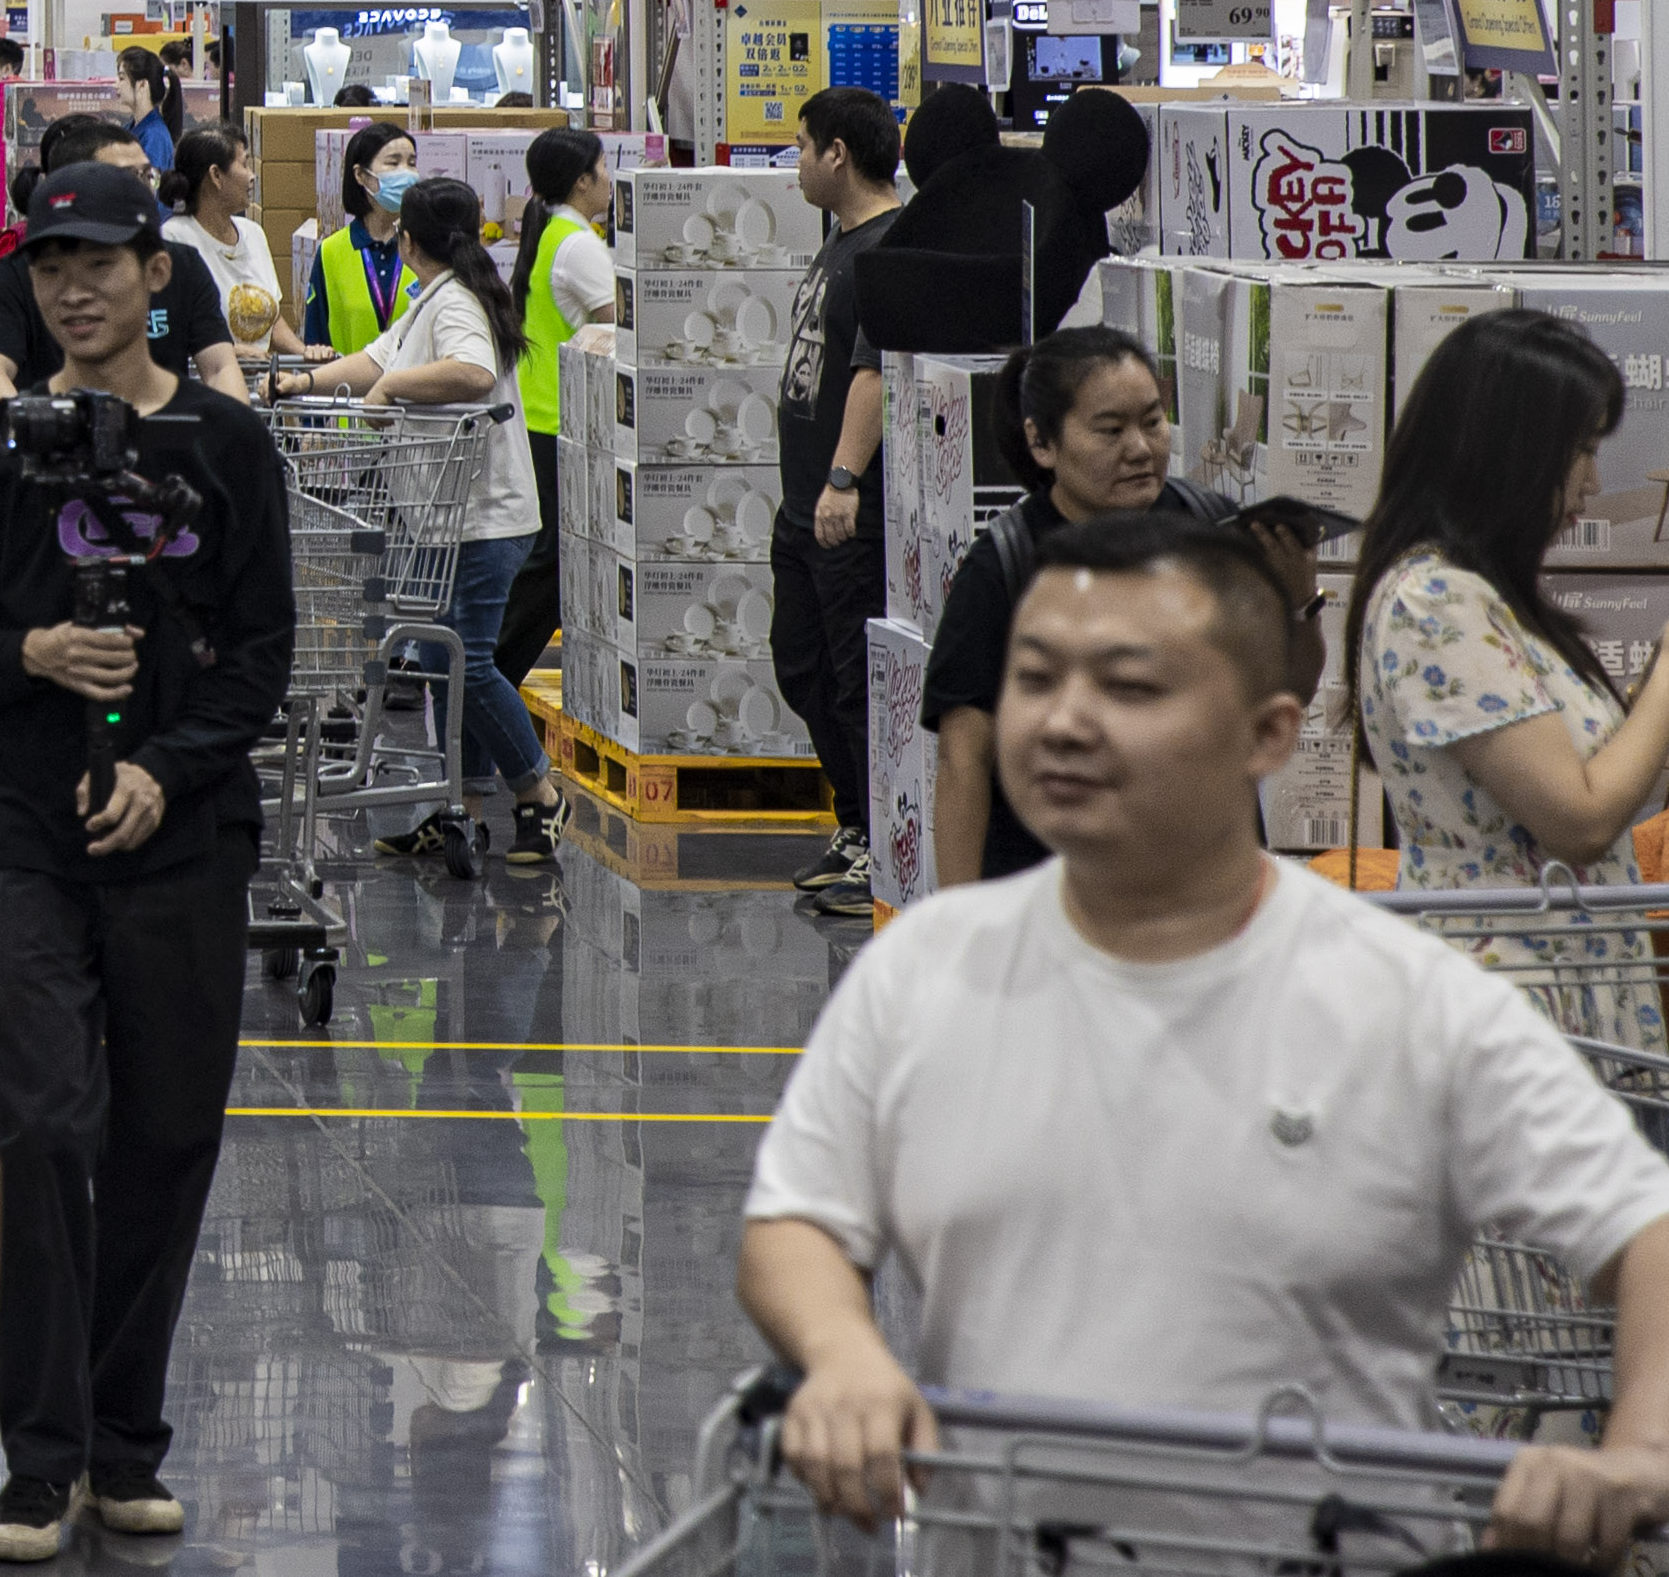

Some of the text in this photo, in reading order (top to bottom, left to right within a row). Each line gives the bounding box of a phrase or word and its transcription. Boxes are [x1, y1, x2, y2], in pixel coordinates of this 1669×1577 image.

[1229, 7, 1270, 25] 69.90
[1580, 310, 1642, 324] SunnyFeel
[1583, 597, 1648, 612] SunnyFeel
